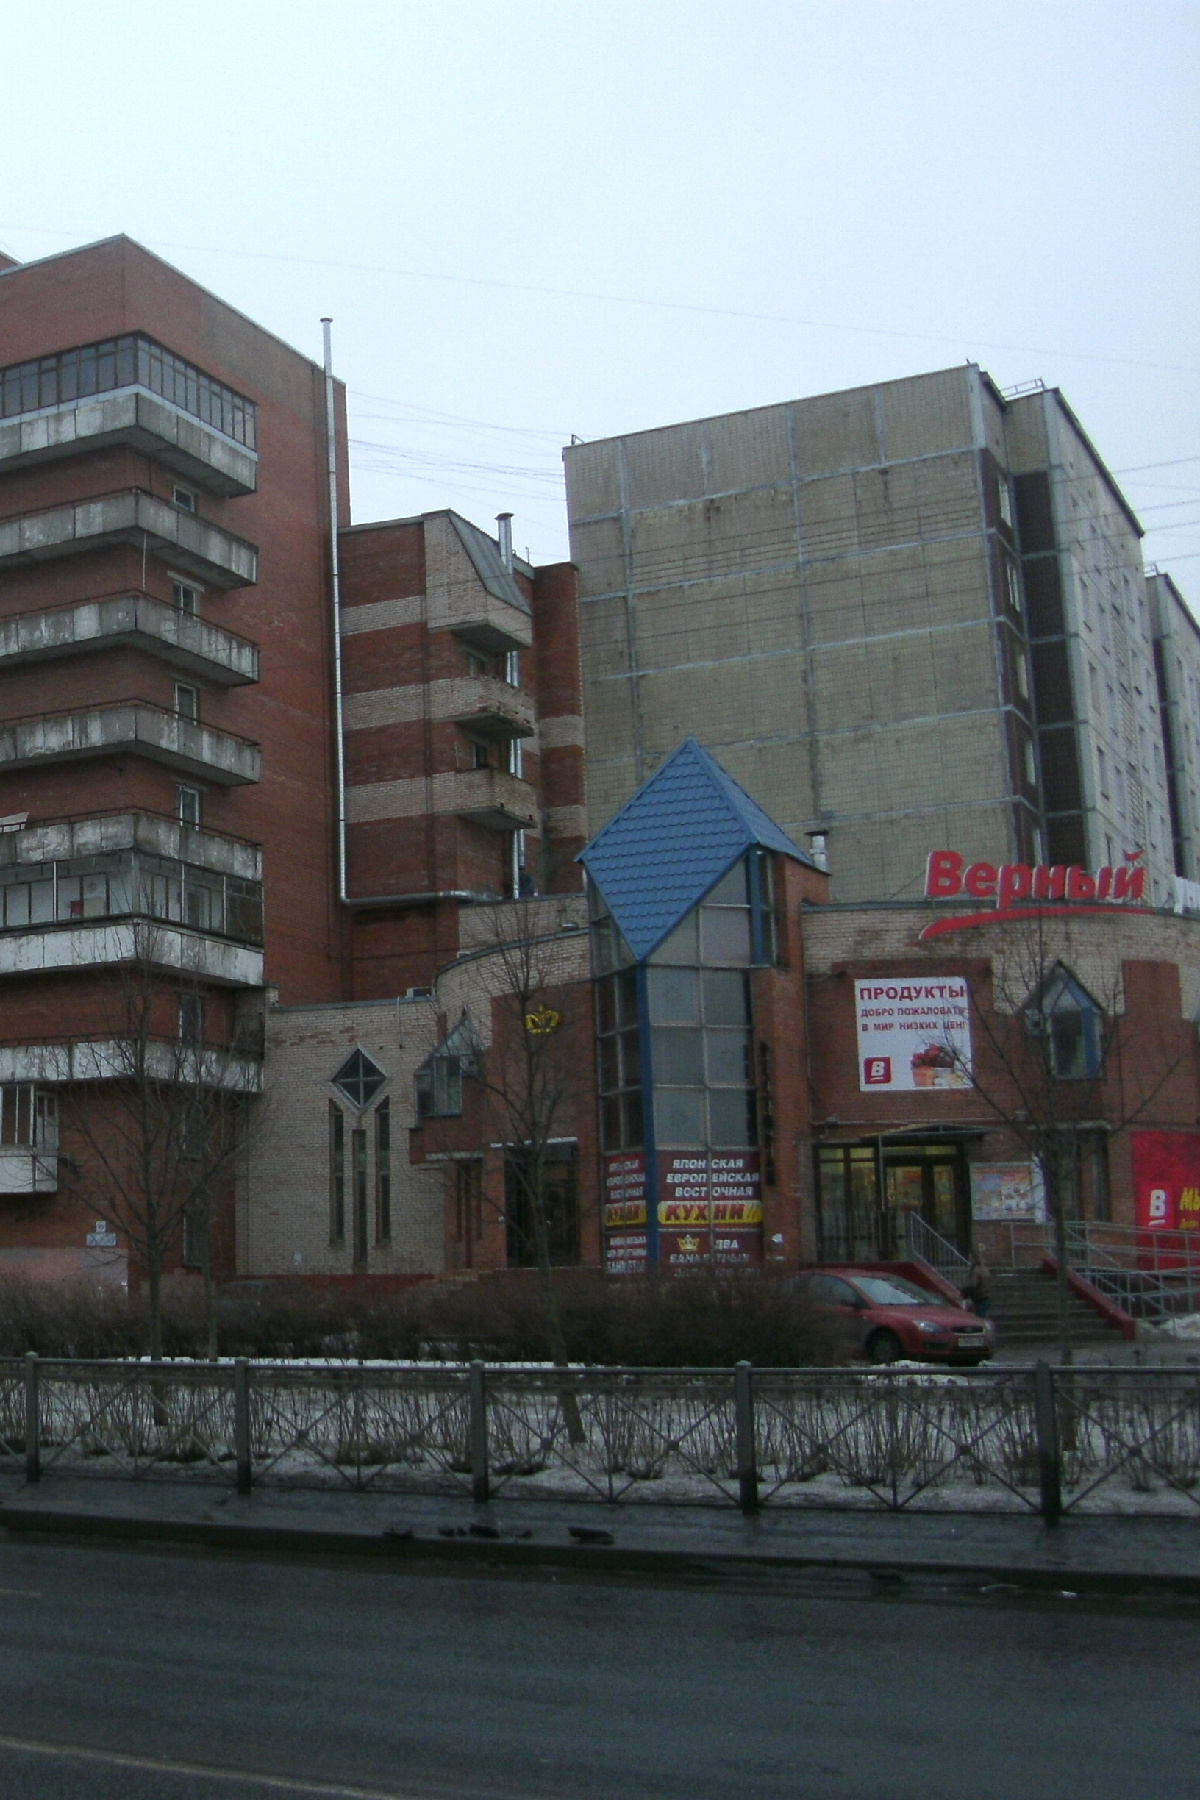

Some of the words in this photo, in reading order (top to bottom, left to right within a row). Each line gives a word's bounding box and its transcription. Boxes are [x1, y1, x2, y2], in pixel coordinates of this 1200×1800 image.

[925, 850, 1147, 909] Верный
[860, 985, 965, 1001] ПРОДУКТЫ
[861, 1008, 894, 1018] ДОБРО
[861, 1023, 869, 1032] В
[874, 1022, 894, 1031] МИР
[899, 1021, 938, 1030] НИЗКИХ
[672, 1159, 744, 1169] ЯПОНСКАЯ
[666, 1171, 760, 1183] ЕВРОПЕЙСКАЯ
[675, 1186, 754, 1197] ВОСТОЧНАЯ
[665, 1204, 746, 1221] КУХНИ
